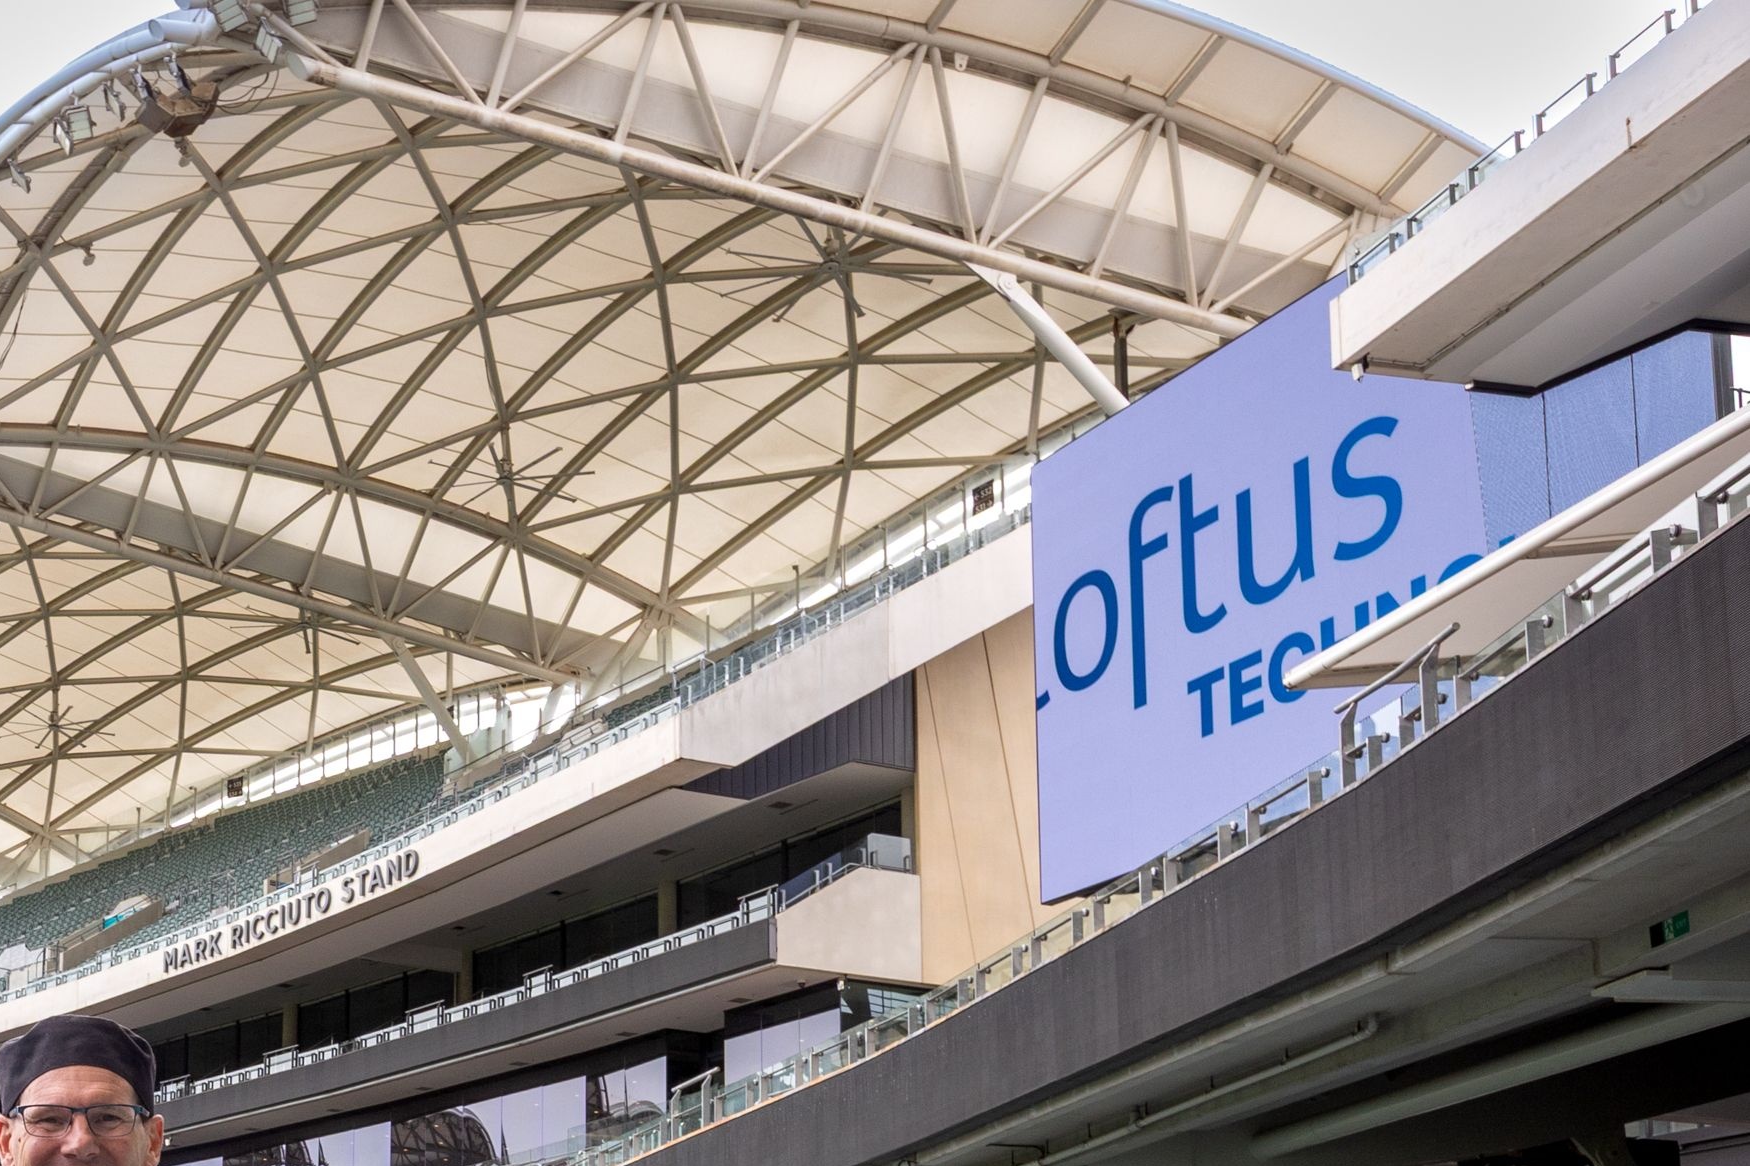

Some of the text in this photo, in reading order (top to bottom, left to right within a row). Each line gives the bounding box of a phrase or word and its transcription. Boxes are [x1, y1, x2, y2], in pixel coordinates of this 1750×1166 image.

[1036, 416, 1403, 710] oftus
[163, 849, 419, 973] MARK RICCIUTO STAND
